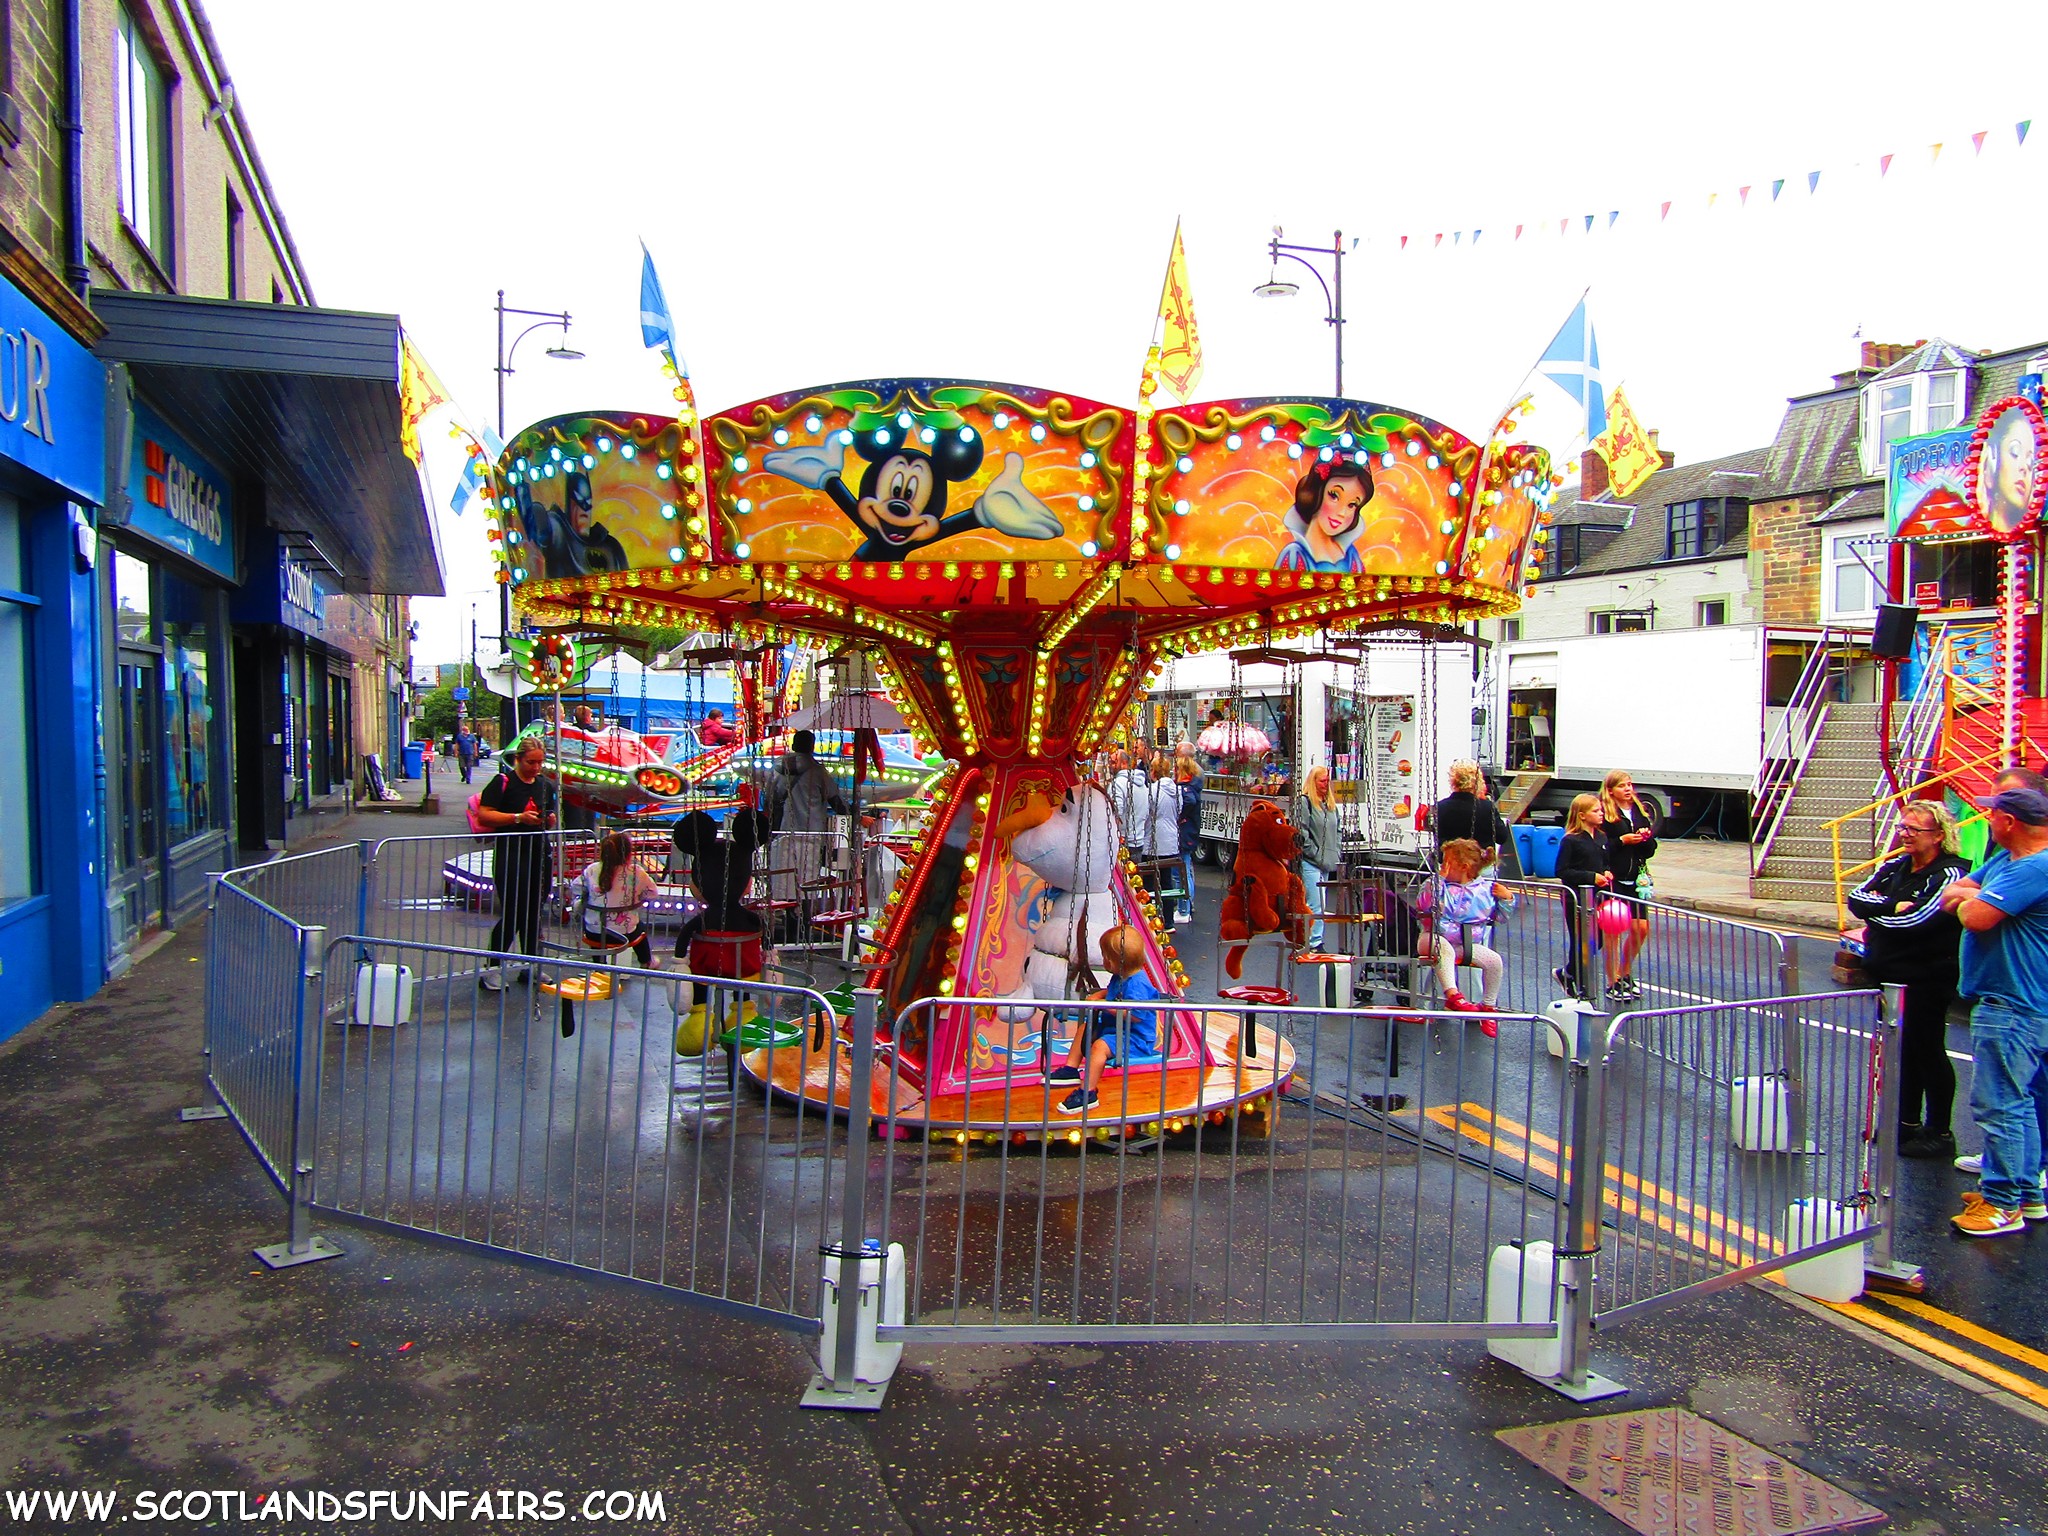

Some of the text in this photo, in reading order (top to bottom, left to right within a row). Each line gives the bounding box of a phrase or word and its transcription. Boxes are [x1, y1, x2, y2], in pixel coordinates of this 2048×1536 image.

[1900, 442, 1948, 477] SUPER
[168, 454, 222, 546] GREGGS
[1200, 809, 1225, 833] HIPS
[1381, 831, 1404, 845] TASTY
[1384, 822, 1402, 835] 100%
[1653, 1451, 1672, 1489] DUCTILE
[1681, 1457, 1700, 1495] DUCTILE
[1710, 1438, 1731, 1480] STAVELEY
[1712, 1487, 1733, 1530] STANTON
